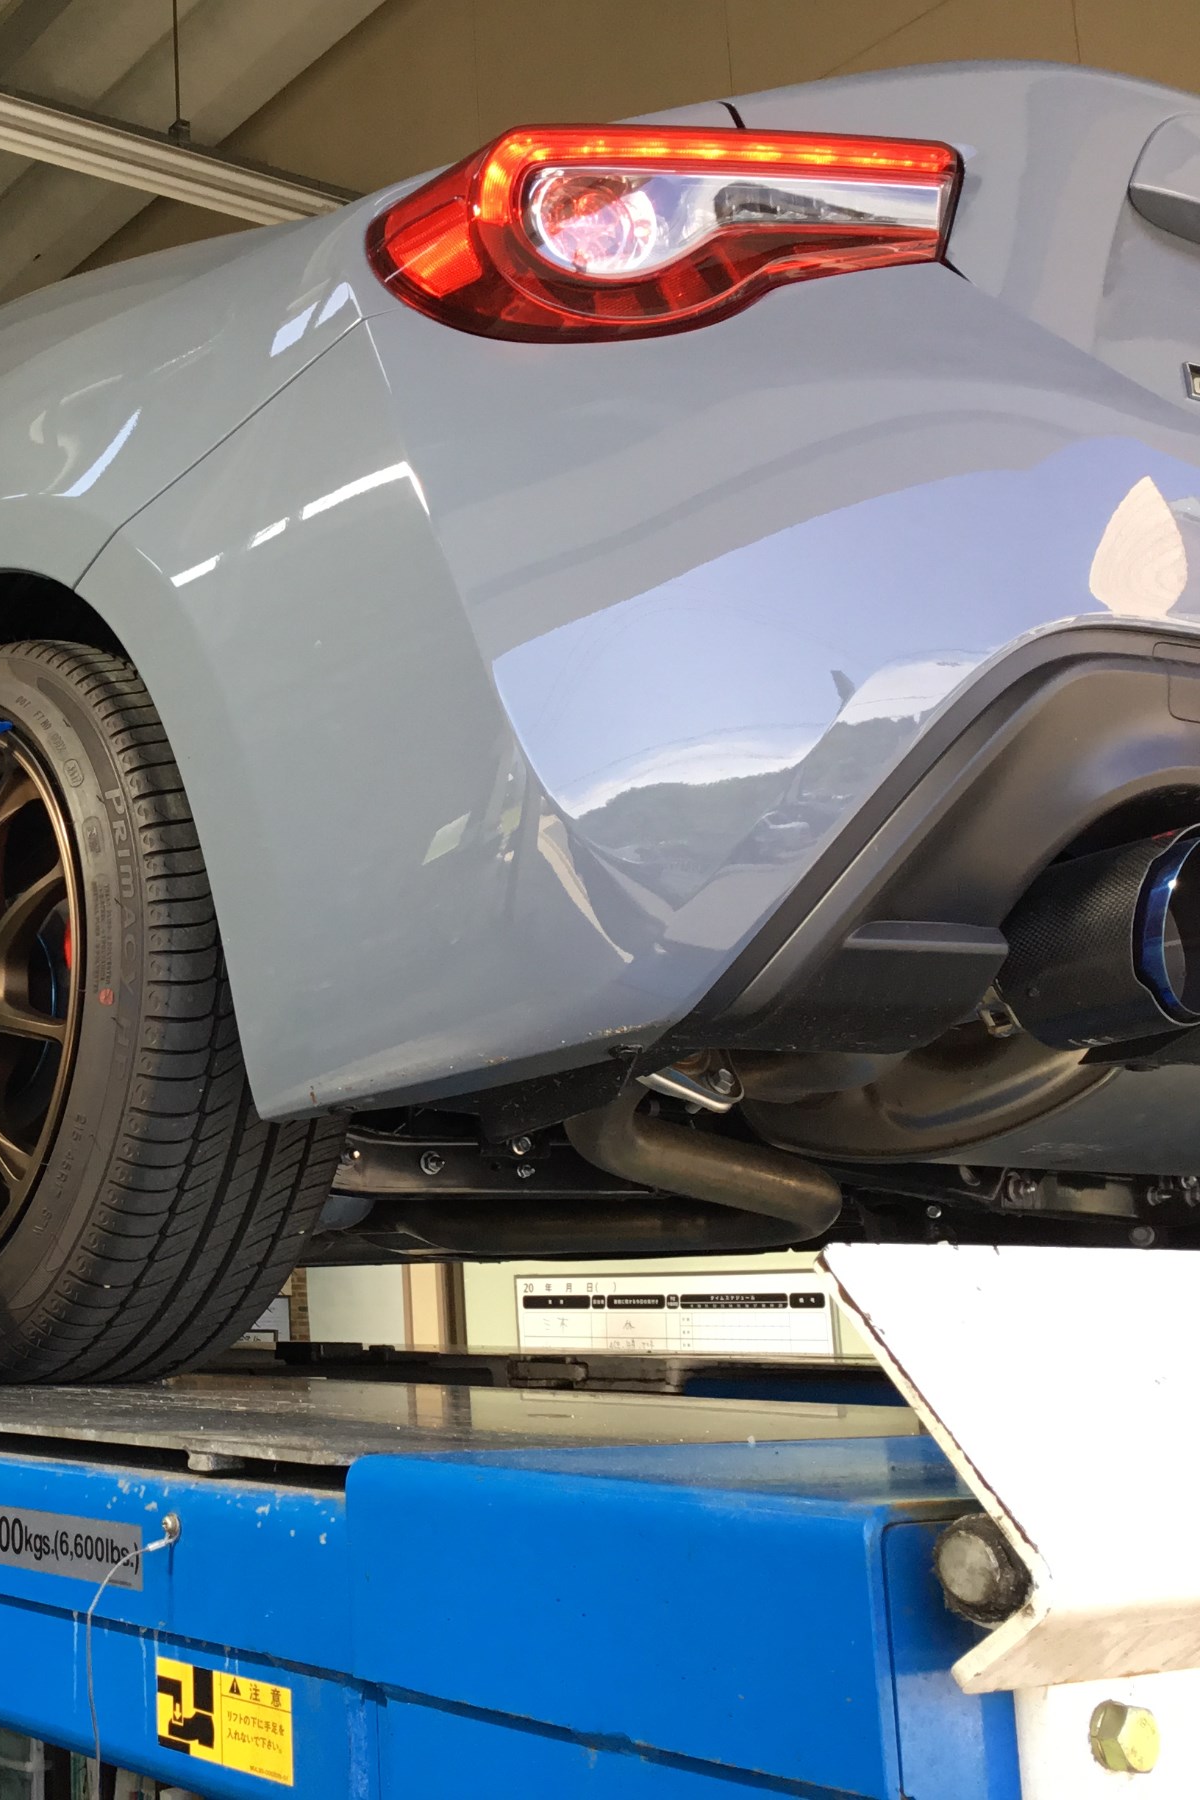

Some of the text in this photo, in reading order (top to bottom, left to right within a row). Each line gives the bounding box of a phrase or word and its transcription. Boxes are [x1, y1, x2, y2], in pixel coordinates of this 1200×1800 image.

[103, 788, 137, 995] PRIMACY
[523, 1283, 534, 1293] 20
[545, 1283, 552, 1292] 年
[566, 1283, 573, 1293] 月
[249, 1683, 282, 1707] 注意
[226, 1710, 285, 1737] リフトの下に手足を
